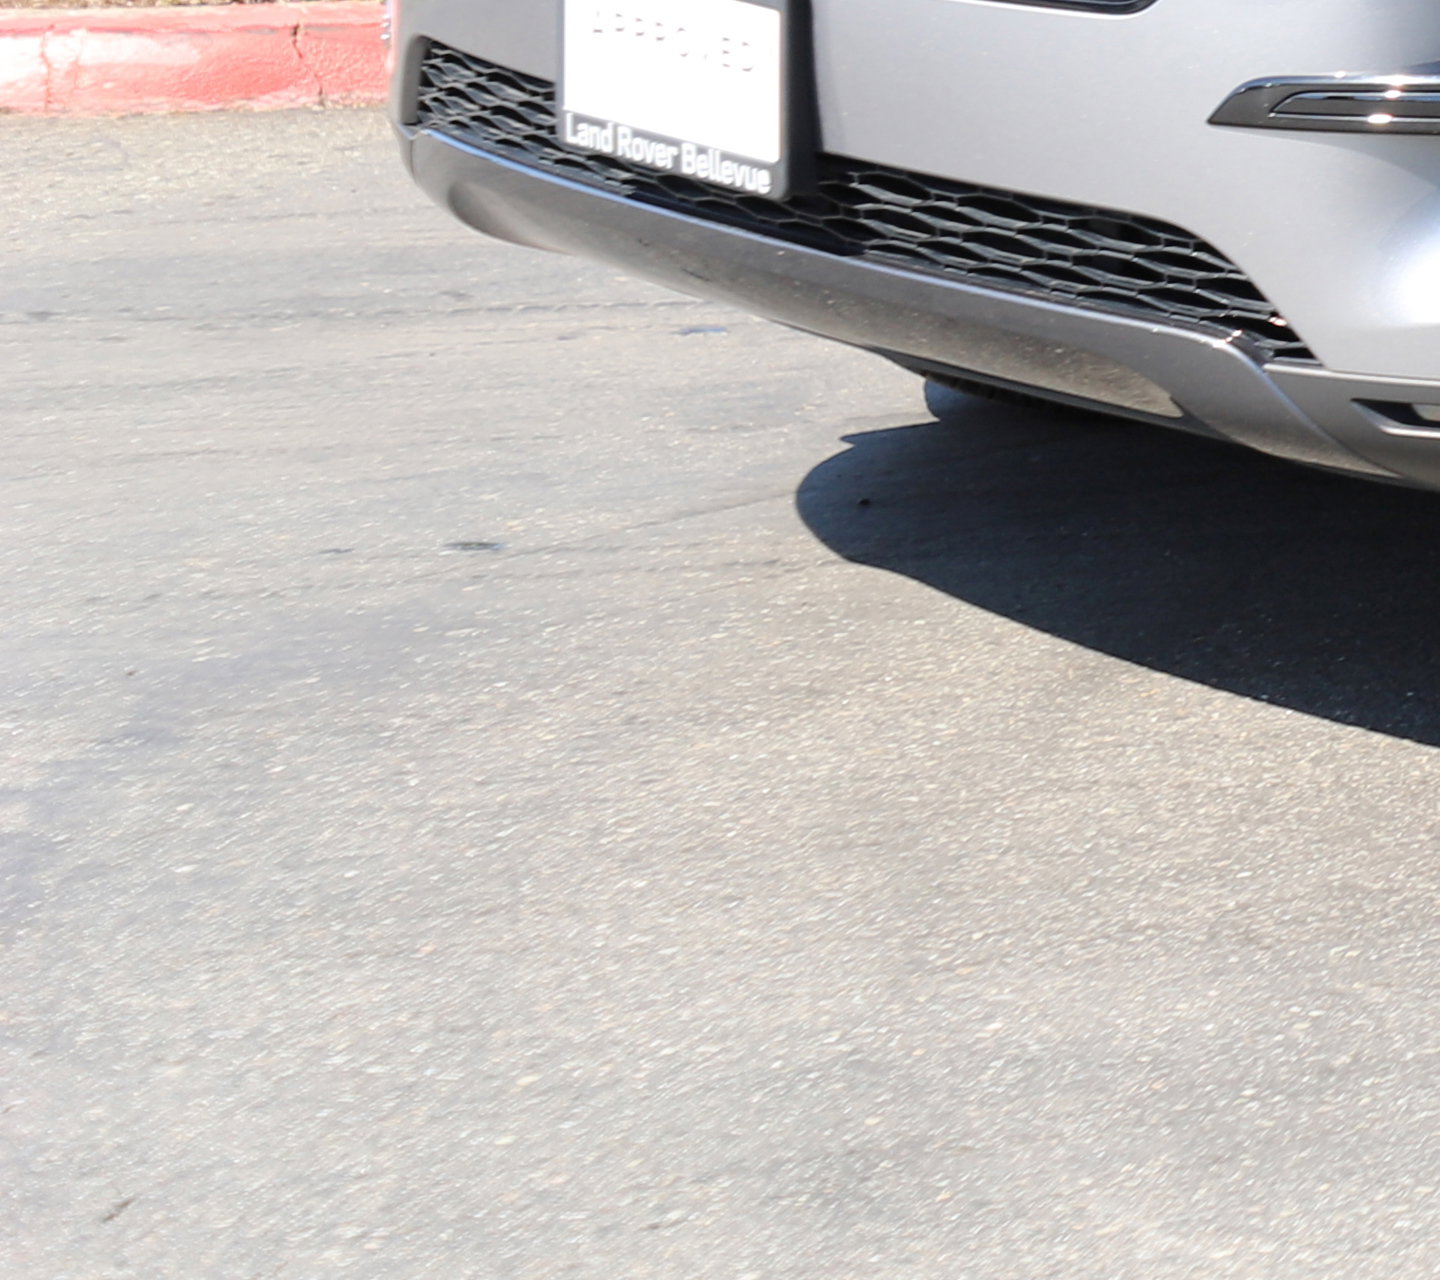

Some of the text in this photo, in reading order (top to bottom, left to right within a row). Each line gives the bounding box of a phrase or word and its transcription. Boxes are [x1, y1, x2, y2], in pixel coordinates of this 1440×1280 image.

[566, 113, 770, 193] Land Rover Bellevue
